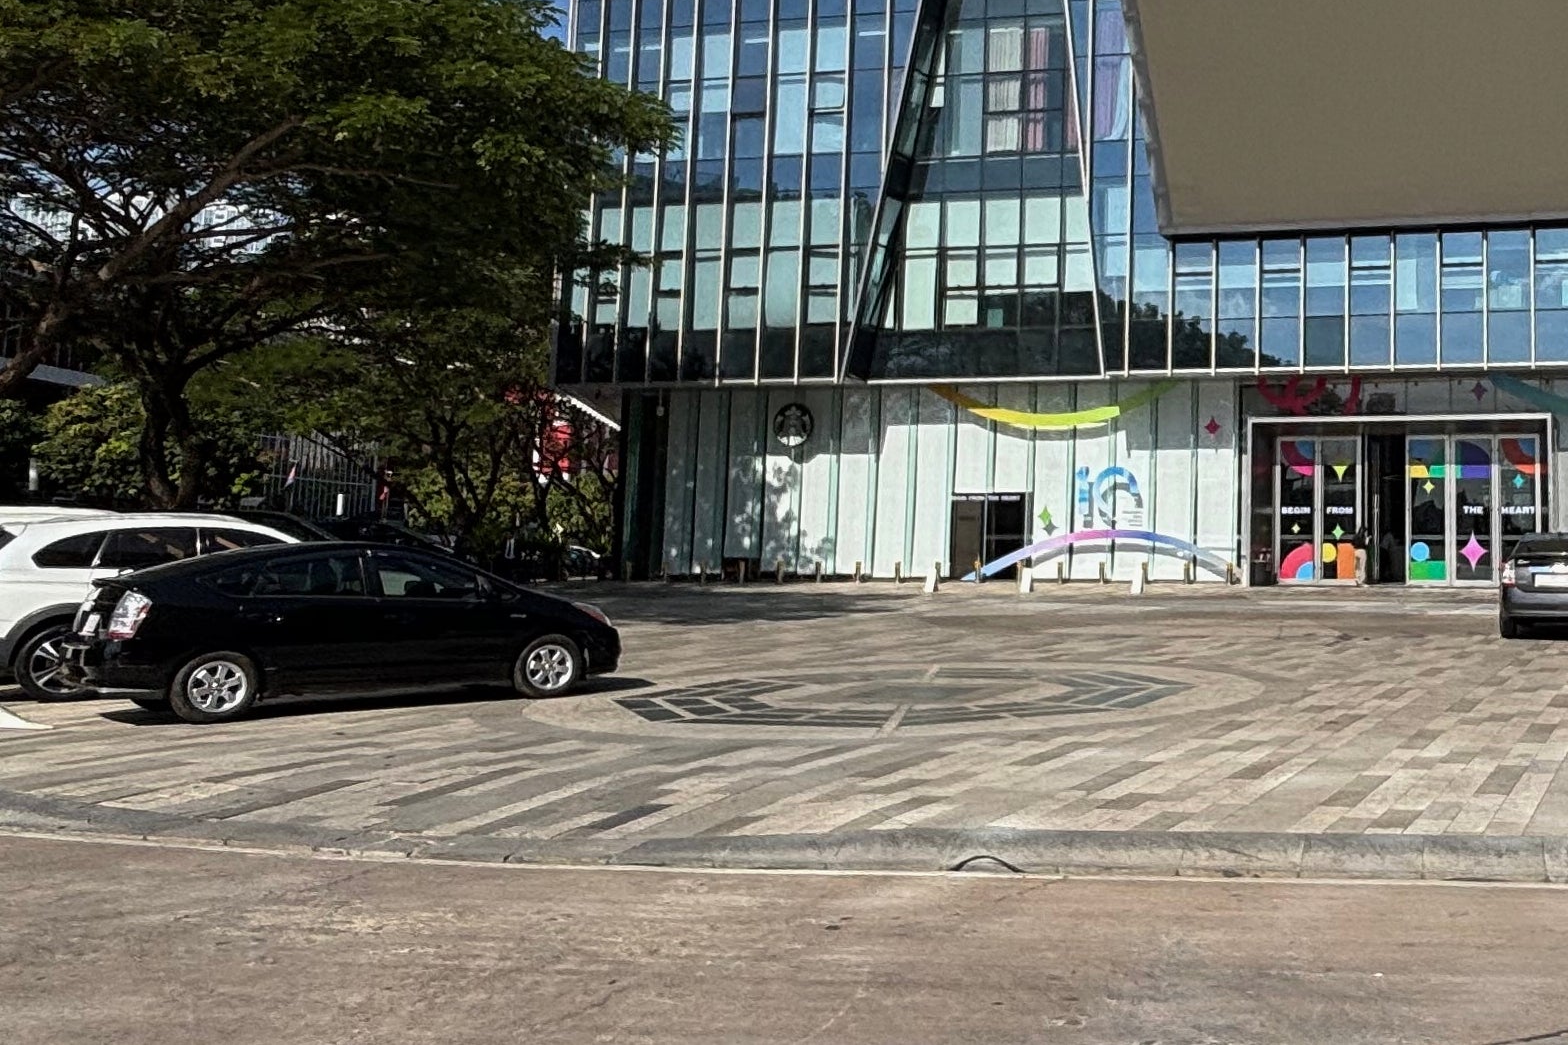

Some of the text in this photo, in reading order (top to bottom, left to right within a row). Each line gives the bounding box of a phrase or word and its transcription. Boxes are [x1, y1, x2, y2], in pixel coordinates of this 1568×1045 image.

[1281, 505, 1535, 515] BEGIN FROM THE HEART
